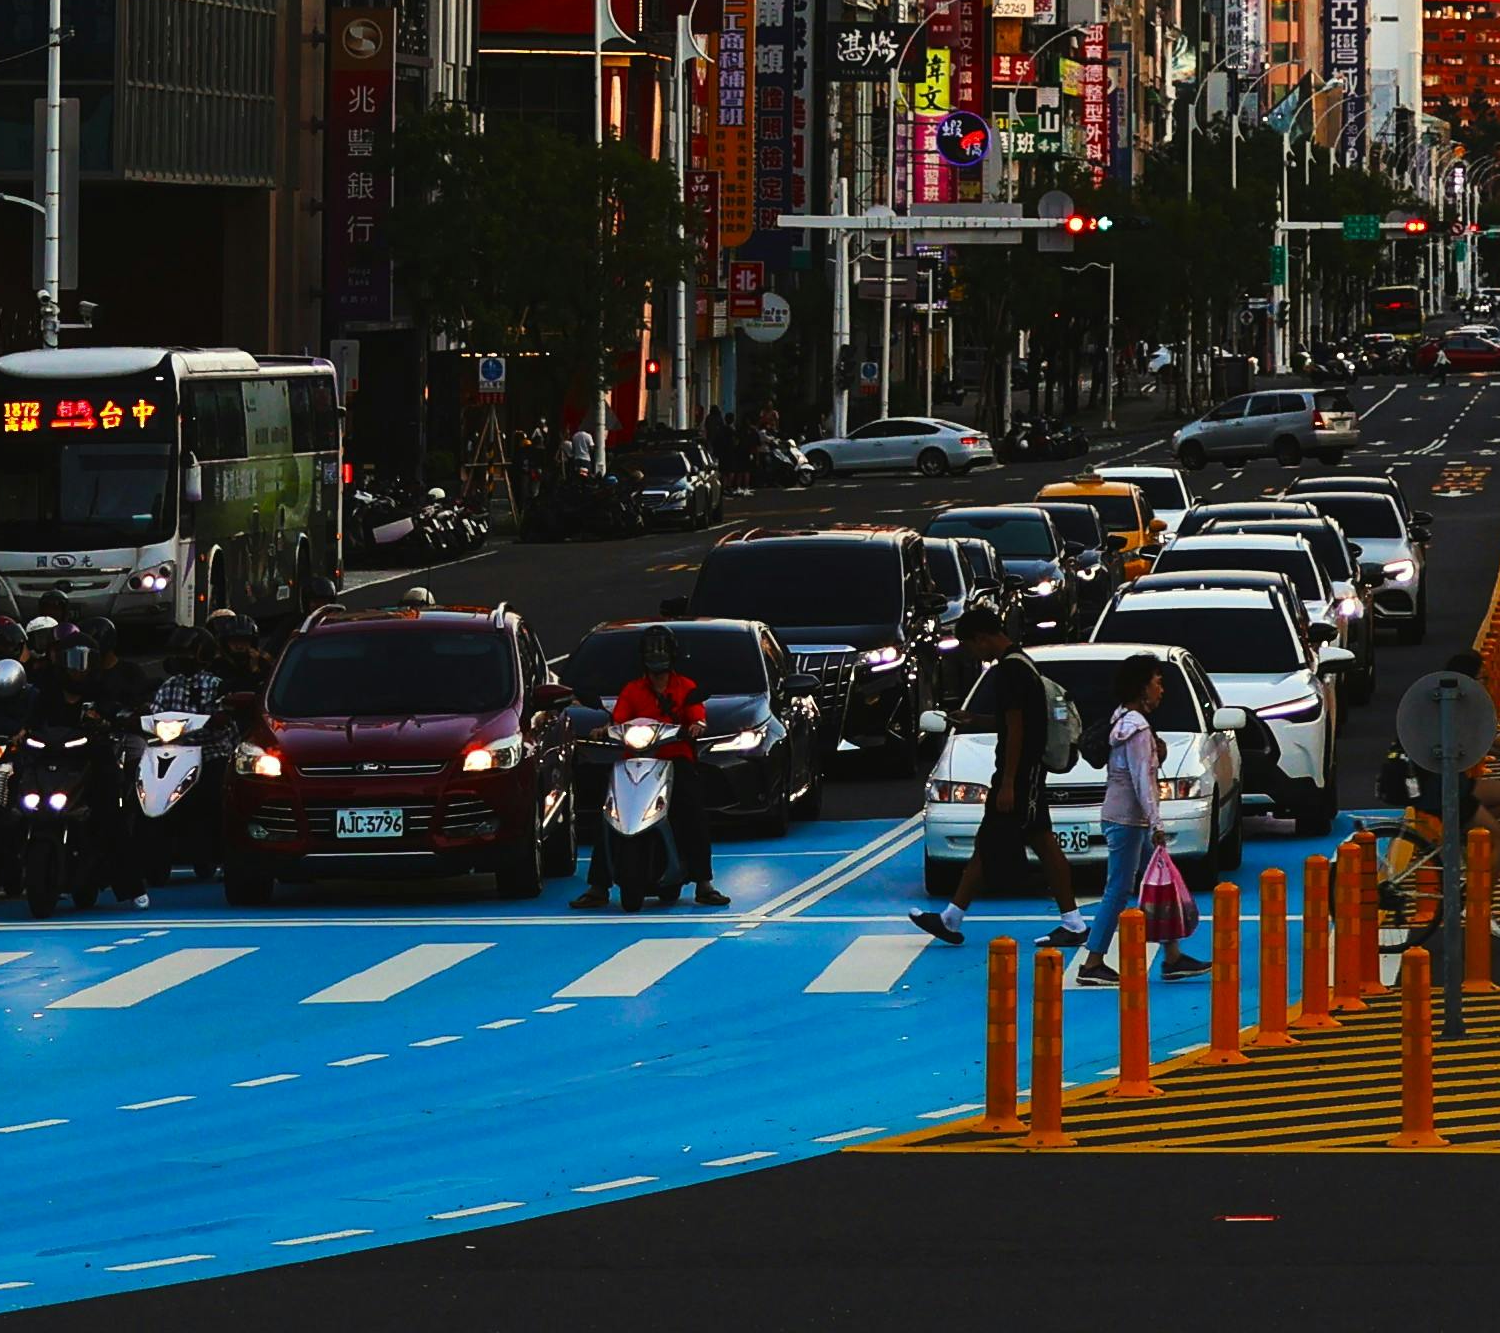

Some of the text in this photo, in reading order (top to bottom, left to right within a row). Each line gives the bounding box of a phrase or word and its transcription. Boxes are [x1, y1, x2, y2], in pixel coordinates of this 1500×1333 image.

[347, 83, 378, 245] 兆豐銀行
[3, 401, 41, 417] 1872
[98, 398, 156, 430] 台中
[36, 555, 93, 568] 國 光
